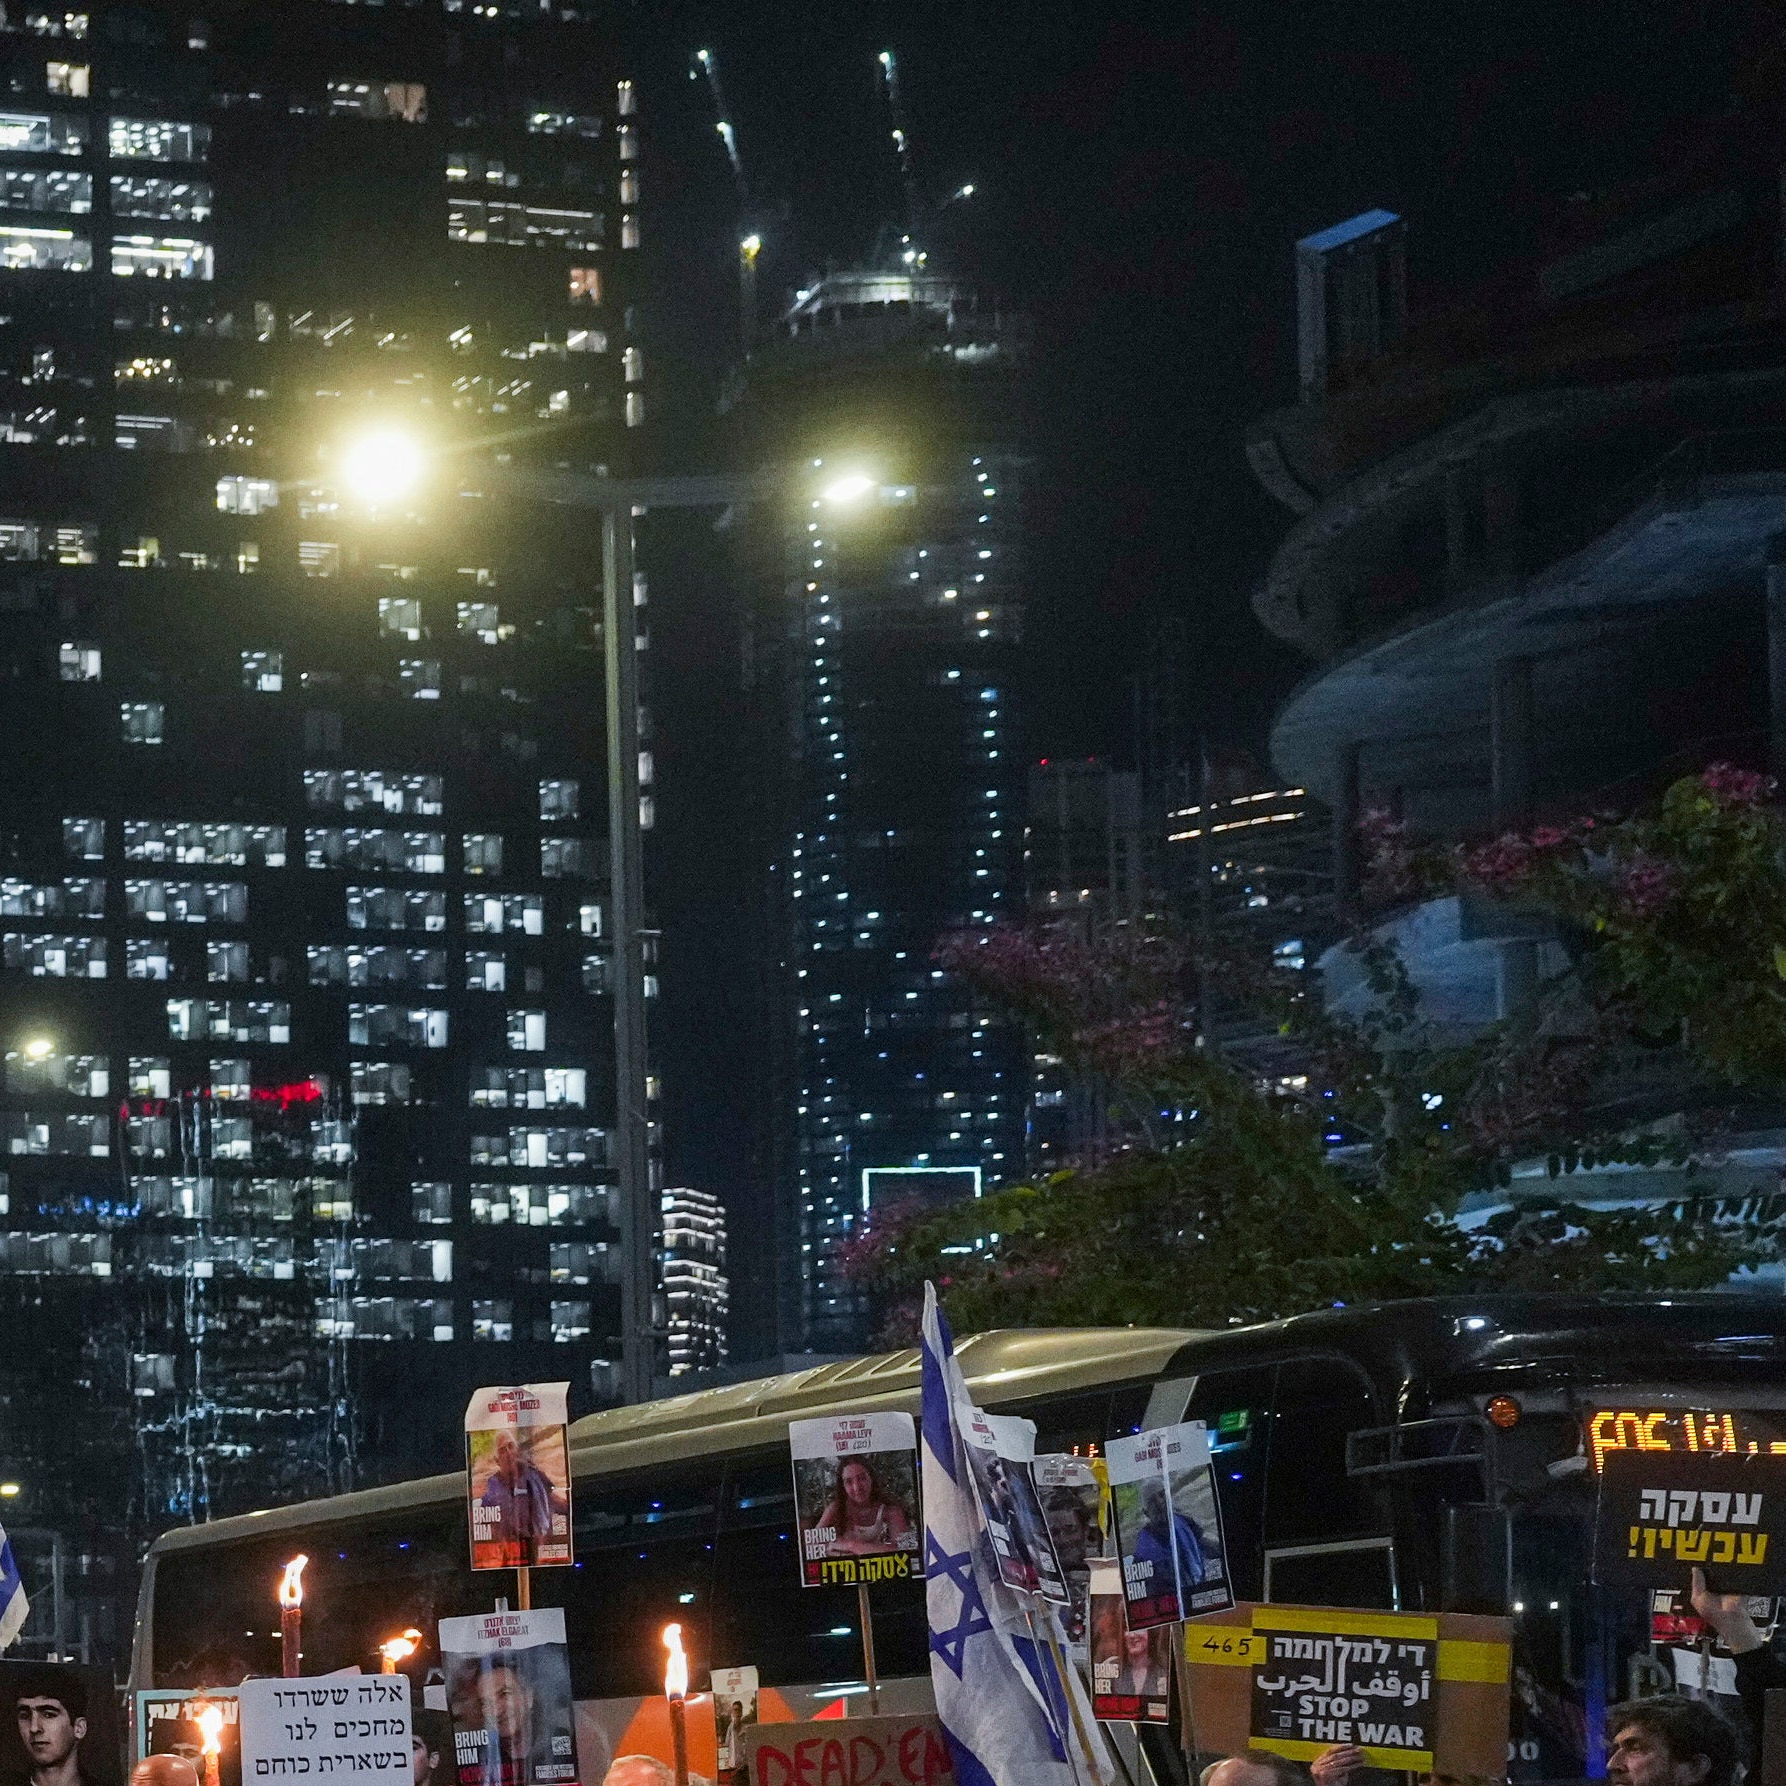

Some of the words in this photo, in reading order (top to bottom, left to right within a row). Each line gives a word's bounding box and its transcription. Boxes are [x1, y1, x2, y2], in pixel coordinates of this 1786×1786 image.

[472, 1506, 501, 1524] BRING
[1639, 1488, 1764, 1528] עסקה
[473, 1523, 493, 1541] HIM
[804, 1527, 837, 1545] BRING
[806, 1544, 827, 1561] HER
[1627, 1526, 1769, 1565] עכשיו!
[821, 1559, 858, 1584] מיד!
[1124, 1560, 1154, 1582] BRING
[1128, 1581, 1148, 1601] HIM
[1202, 1635, 1253, 1656] 465
[1398, 1643, 1427, 1667] די
[1273, 1636, 1392, 1682] למלחמה
[1094, 1662, 1119, 1679] BRING
[358, 1680, 404, 1705] אלה
[1095, 1678, 1112, 1694] HER
[1256, 1670, 1346, 1699] الحرب
[1352, 1669, 1432, 1707] أوقف
[273, 1687, 350, 1709] ששרדו
[1298, 1694, 1370, 1719] STOP
[285, 1716, 318, 1742] לנו
[333, 1718, 406, 1739] מחכים
[454, 1730, 489, 1749] BRING
[1298, 1718, 1353, 1742] THE
[1357, 1721, 1425, 1748] WAR
[255, 1755, 311, 1776] כוחם
[318, 1751, 408, 1773] בשארית
[456, 1748, 479, 1766] HIM
